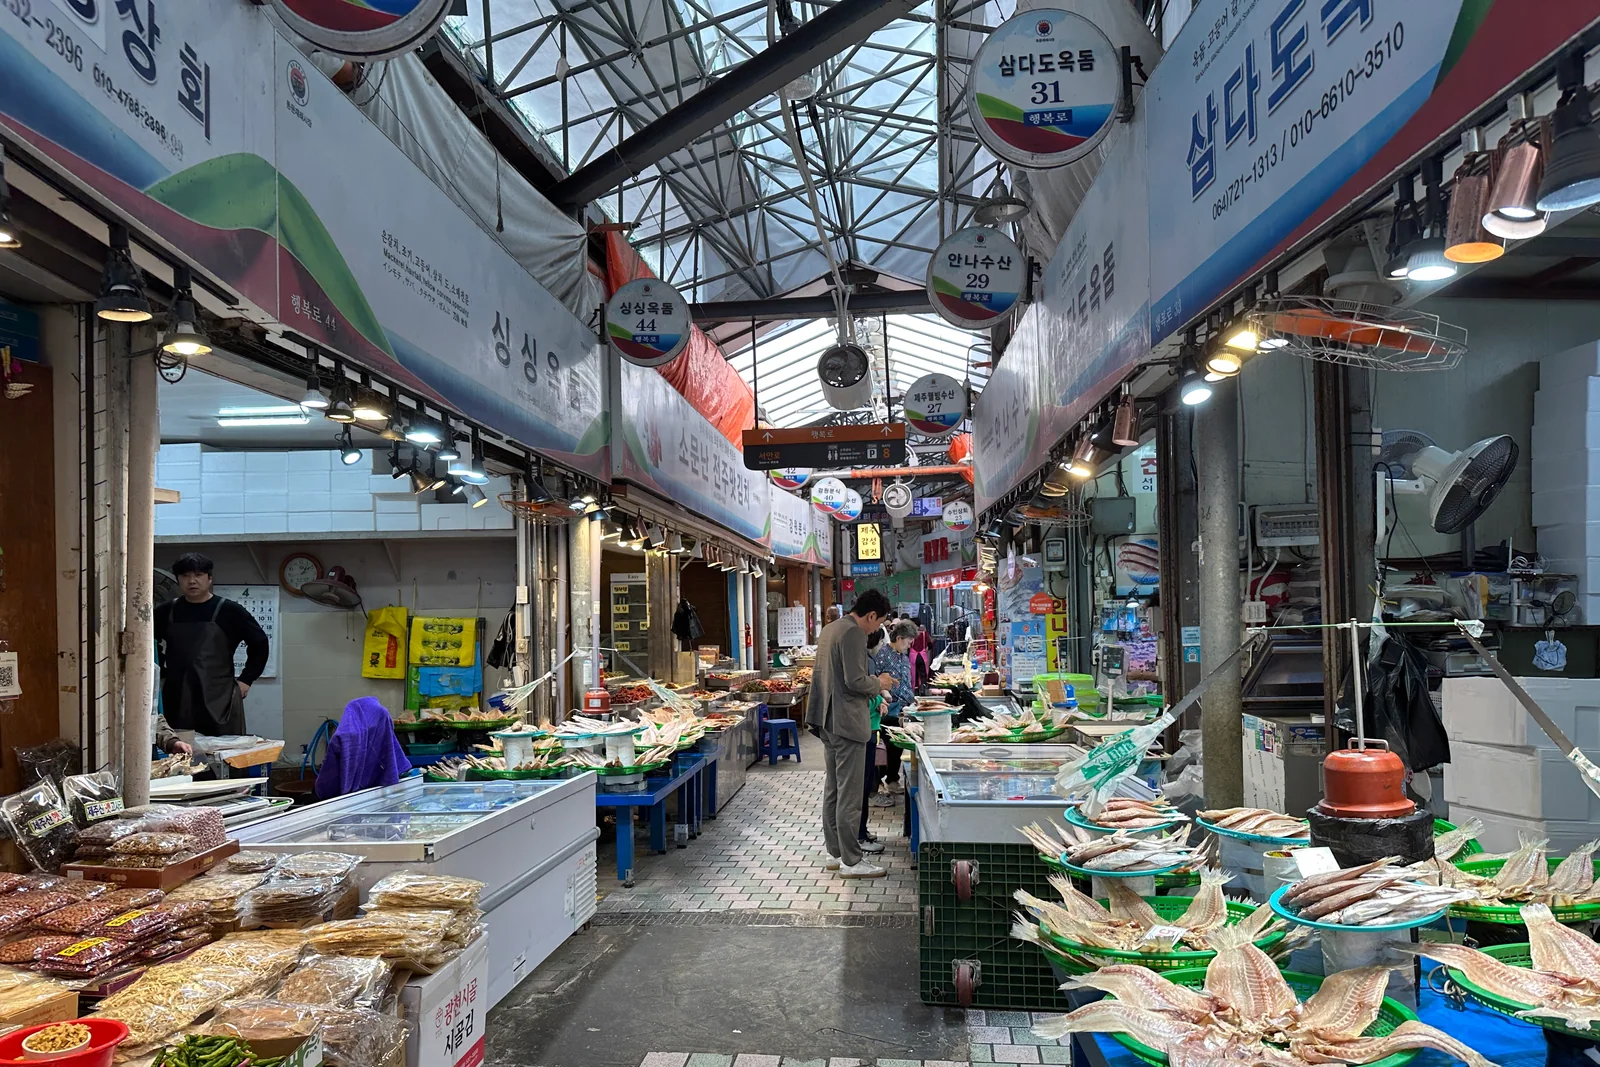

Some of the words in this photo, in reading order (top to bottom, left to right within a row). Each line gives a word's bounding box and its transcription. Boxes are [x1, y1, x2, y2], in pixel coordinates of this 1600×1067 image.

[998, 50, 1095, 77] 삼다도옥돔
[1031, 80, 1065, 104] 31
[1029, 112, 1068, 125] 행복로
[1212, 138, 1277, 221] 064)721-1313
[1290, 21, 1404, 149] 010-6610-3510
[947, 253, 1012, 271] 안나수산
[965, 273, 990, 289] 29
[290, 293, 322, 324] 행복로
[325, 314, 337, 331] 44
[619, 301, 674, 315] 싱싱옥돔
[635, 318, 657, 332] 44
[1155, 306, 1172, 332] 행복로
[491, 310, 581, 413] 싱싱옥돔
[927, 403, 942, 414] 27
[810, 430, 835, 440] 행복로
[678, 426, 709, 482] 소문난
[758, 451, 781, 461] 서안로
[882, 447, 891, 459] 8
[242, 588, 250, 597] 4
[444, 977, 478, 1027] 광천시골
[443, 1008, 474, 1056] 시골김
